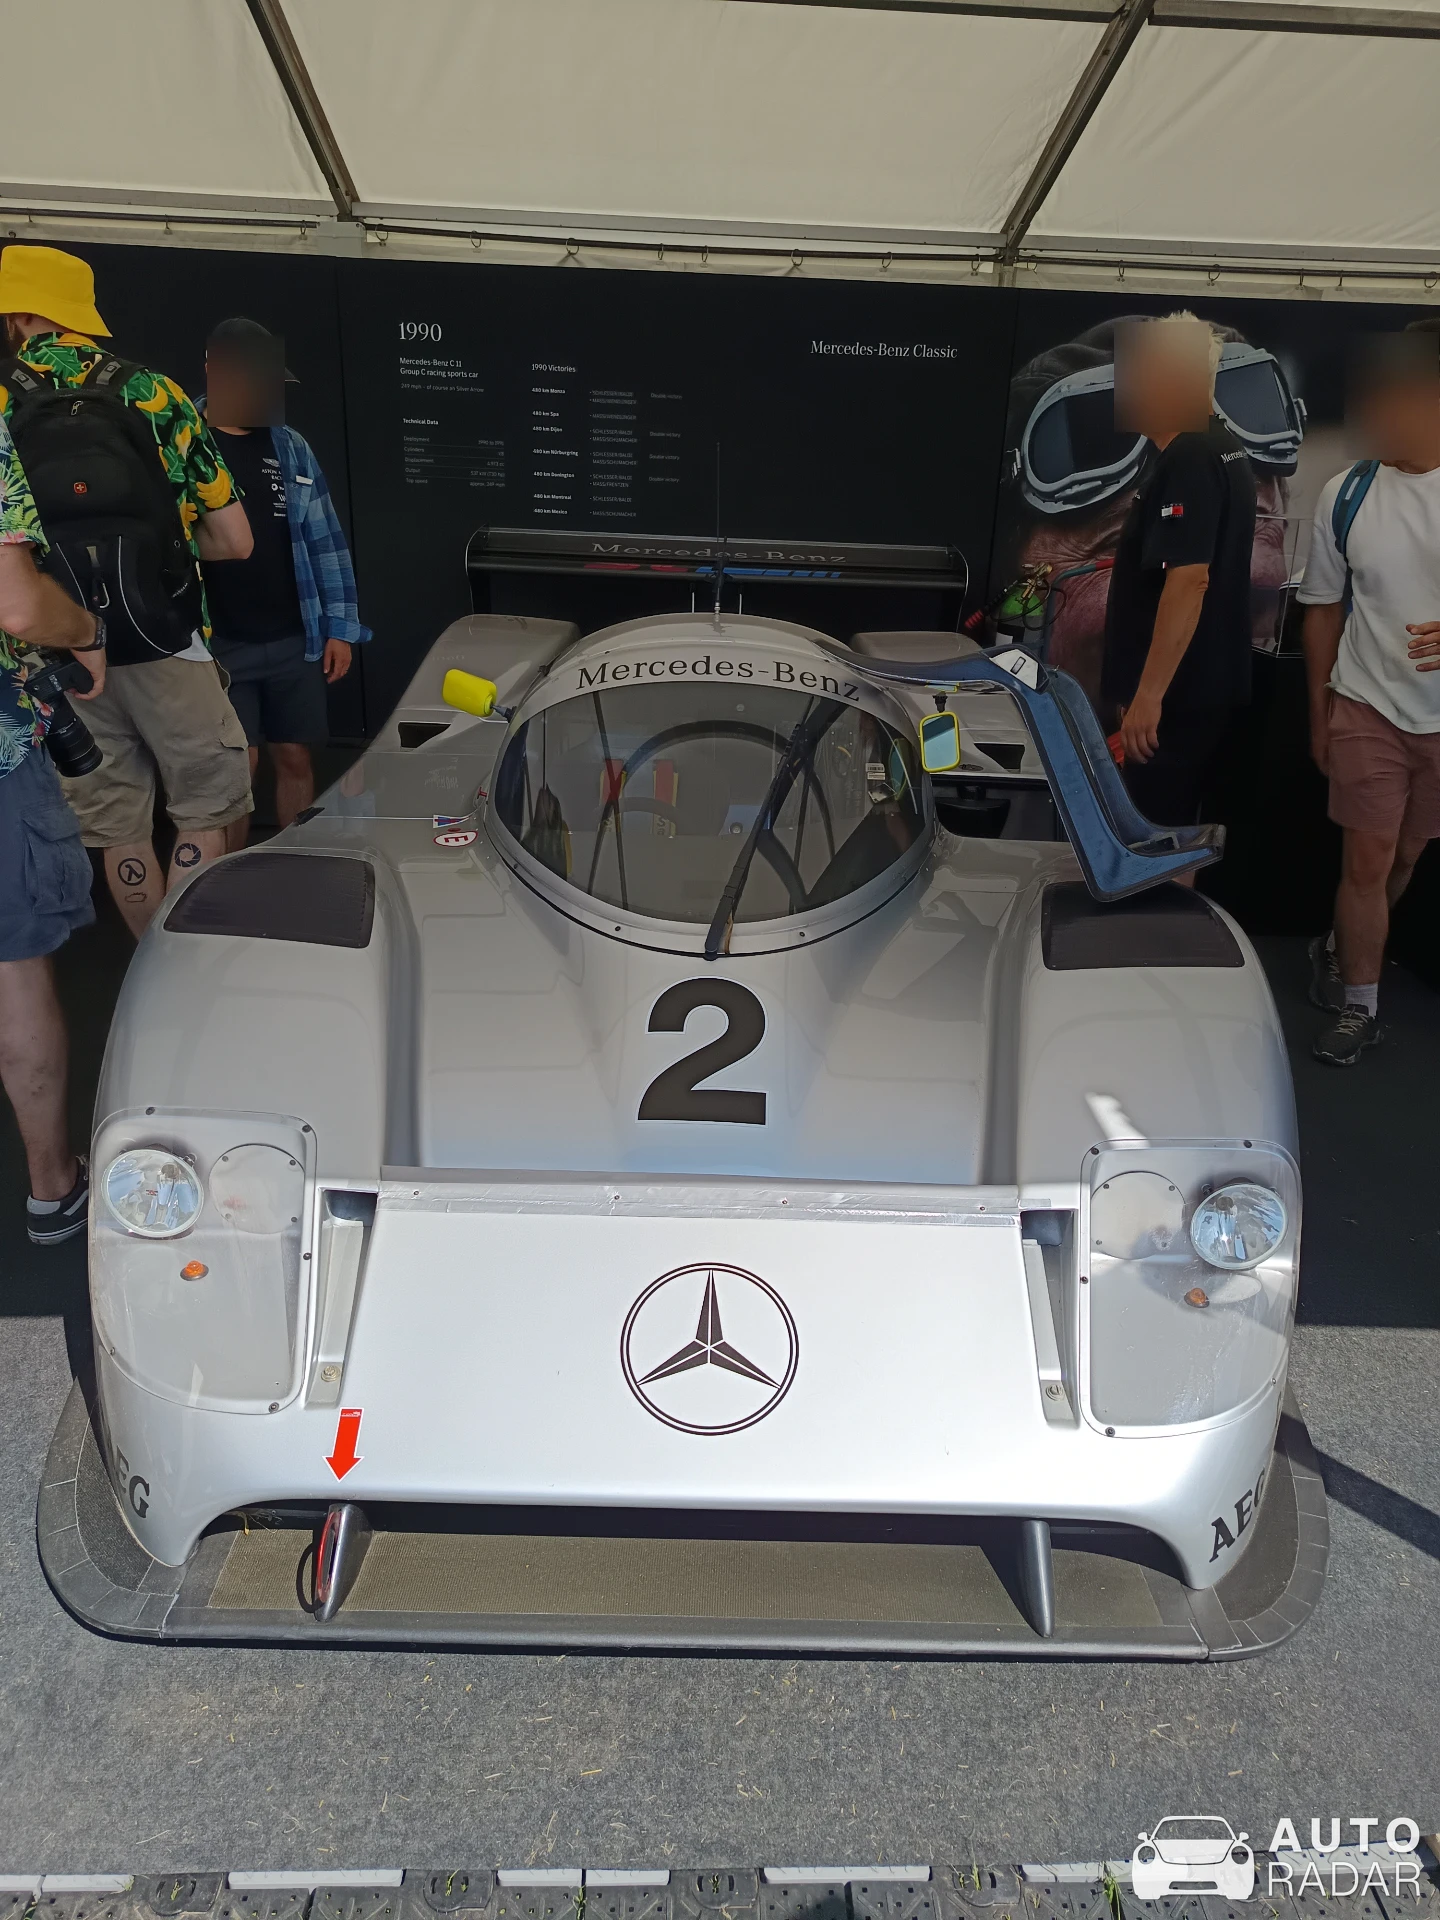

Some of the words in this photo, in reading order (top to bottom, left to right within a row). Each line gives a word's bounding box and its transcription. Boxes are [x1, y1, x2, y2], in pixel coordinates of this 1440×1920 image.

[398, 321, 442, 342] 1990
[810, 340, 910, 357] Mercedes-Benz
[913, 343, 958, 358] Classic
[399, 357, 449, 367] Mercedes-Benz
[449, 359, 455, 367] C
[455, 360, 462, 368] 11
[531, 363, 548, 372] 1990
[548, 364, 577, 373] Victories
[400, 367, 420, 377] Group
[420, 368, 426, 376] C
[426, 369, 447, 378] racing
[447, 370, 468, 379] sports
[402, 417, 426, 425] Technical
[590, 543, 847, 563] Mercedes-Benz
[575, 655, 860, 702] Mercedes-Benz
[637, 977, 767, 1126] 2
[113, 1444, 150, 1519] EG
